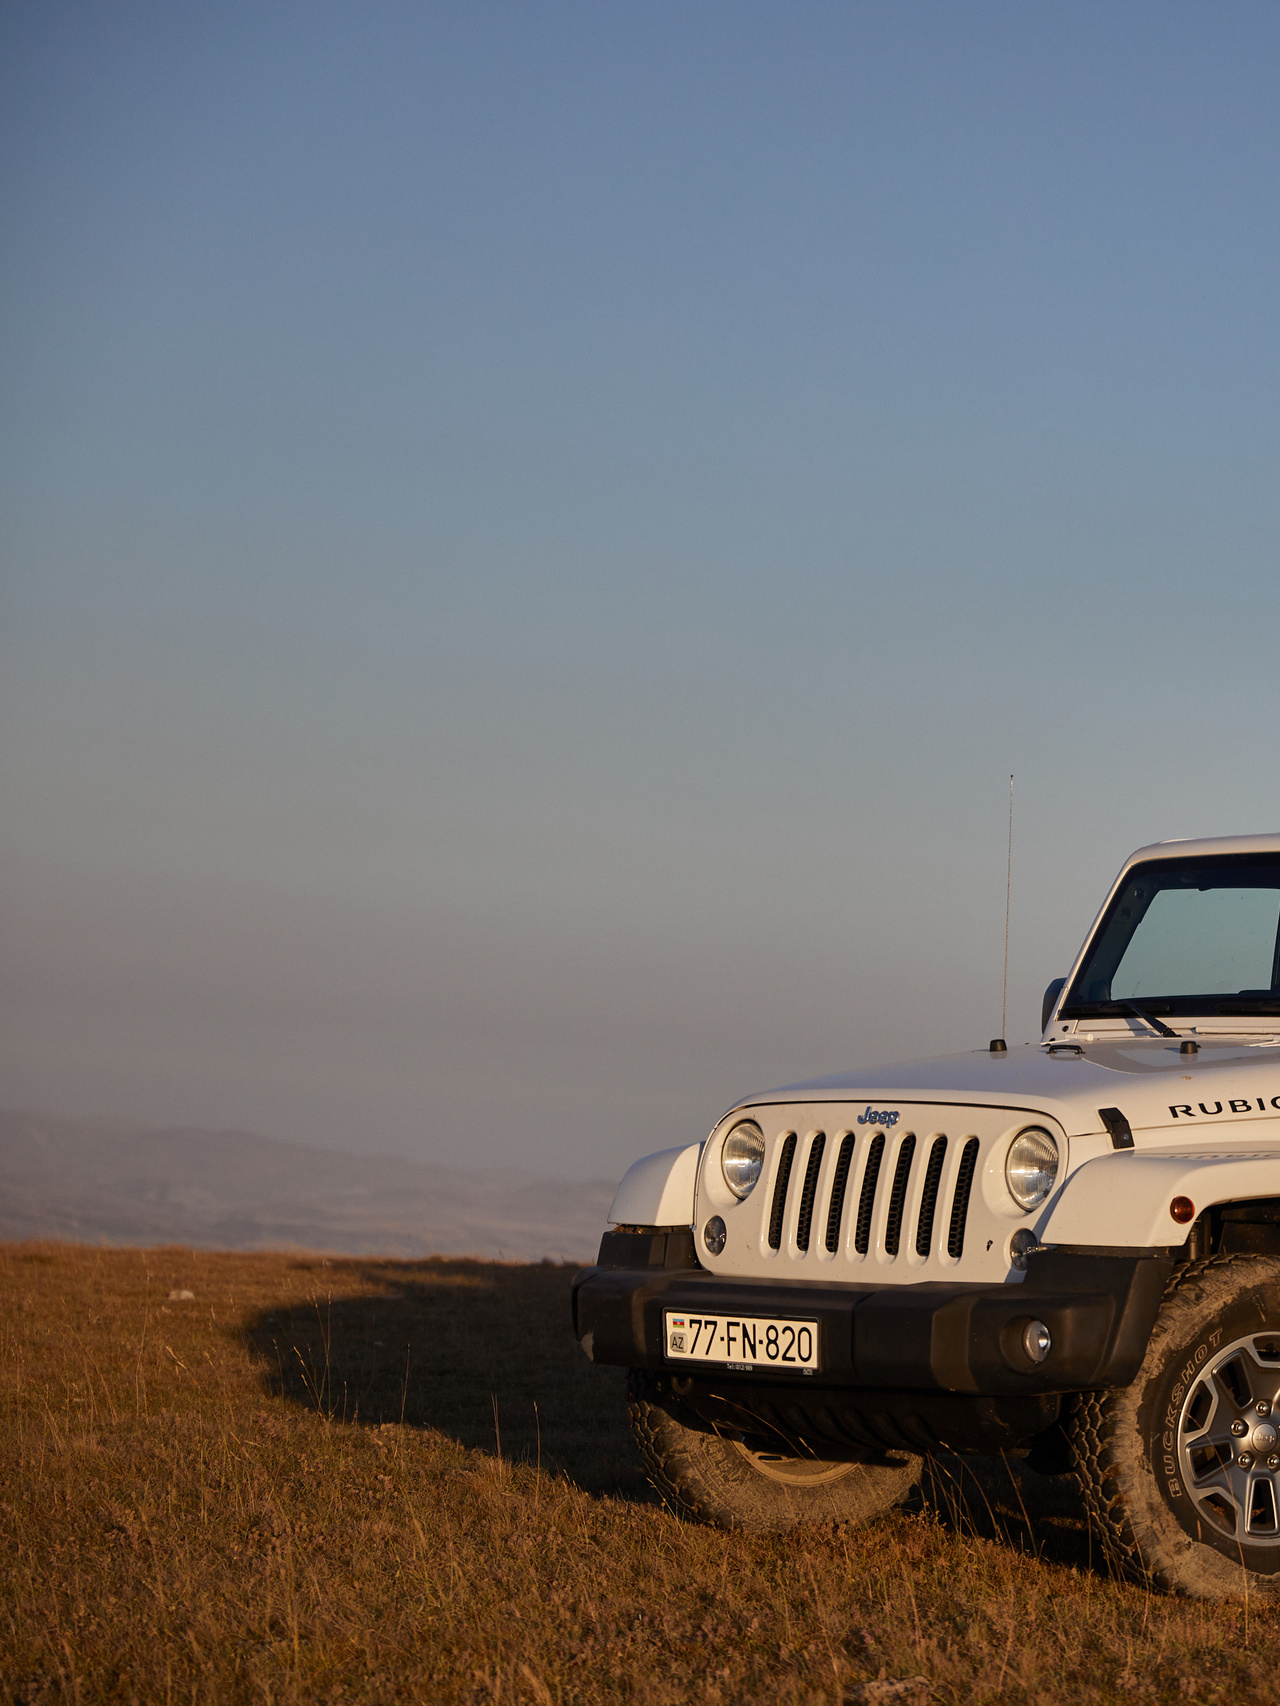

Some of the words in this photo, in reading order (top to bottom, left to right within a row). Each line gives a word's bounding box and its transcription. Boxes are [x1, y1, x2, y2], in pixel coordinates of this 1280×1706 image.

[857, 1106, 899, 1128] Jeep
[672, 1336, 684, 1350] AZ
[1163, 1329, 1224, 1497] BUCKSHOT
